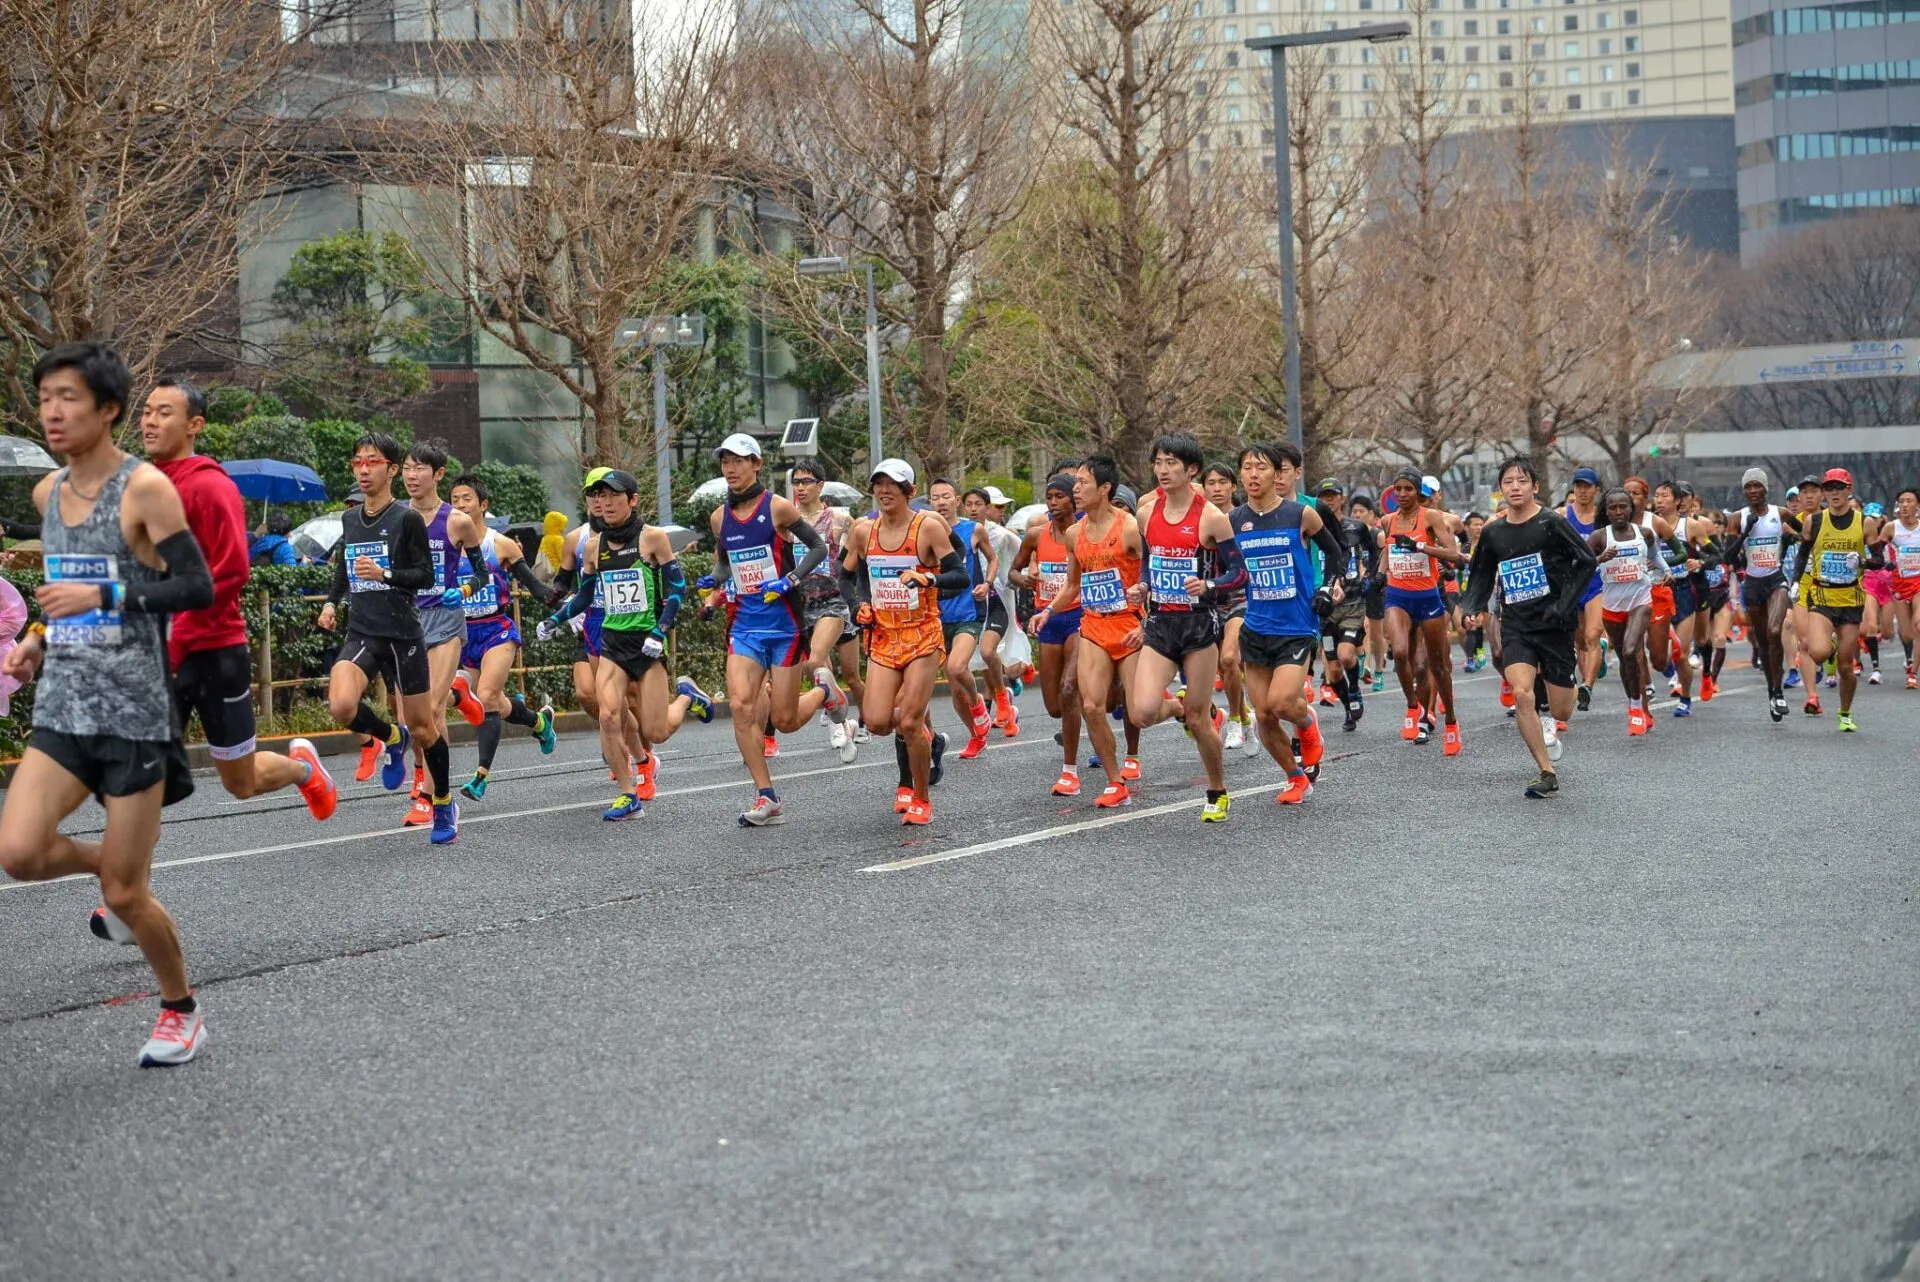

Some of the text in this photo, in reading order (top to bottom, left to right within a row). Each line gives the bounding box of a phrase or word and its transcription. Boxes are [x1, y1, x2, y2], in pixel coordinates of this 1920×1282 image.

[737, 564, 756, 572] PACE
[1394, 562, 1424, 571] MELESE
[740, 571, 763, 584] MAKI
[1250, 569, 1285, 587] A4011
[1503, 569, 1539, 591] A4252
[610, 583, 640, 604] 152
[1081, 584, 1116, 602] A4203
